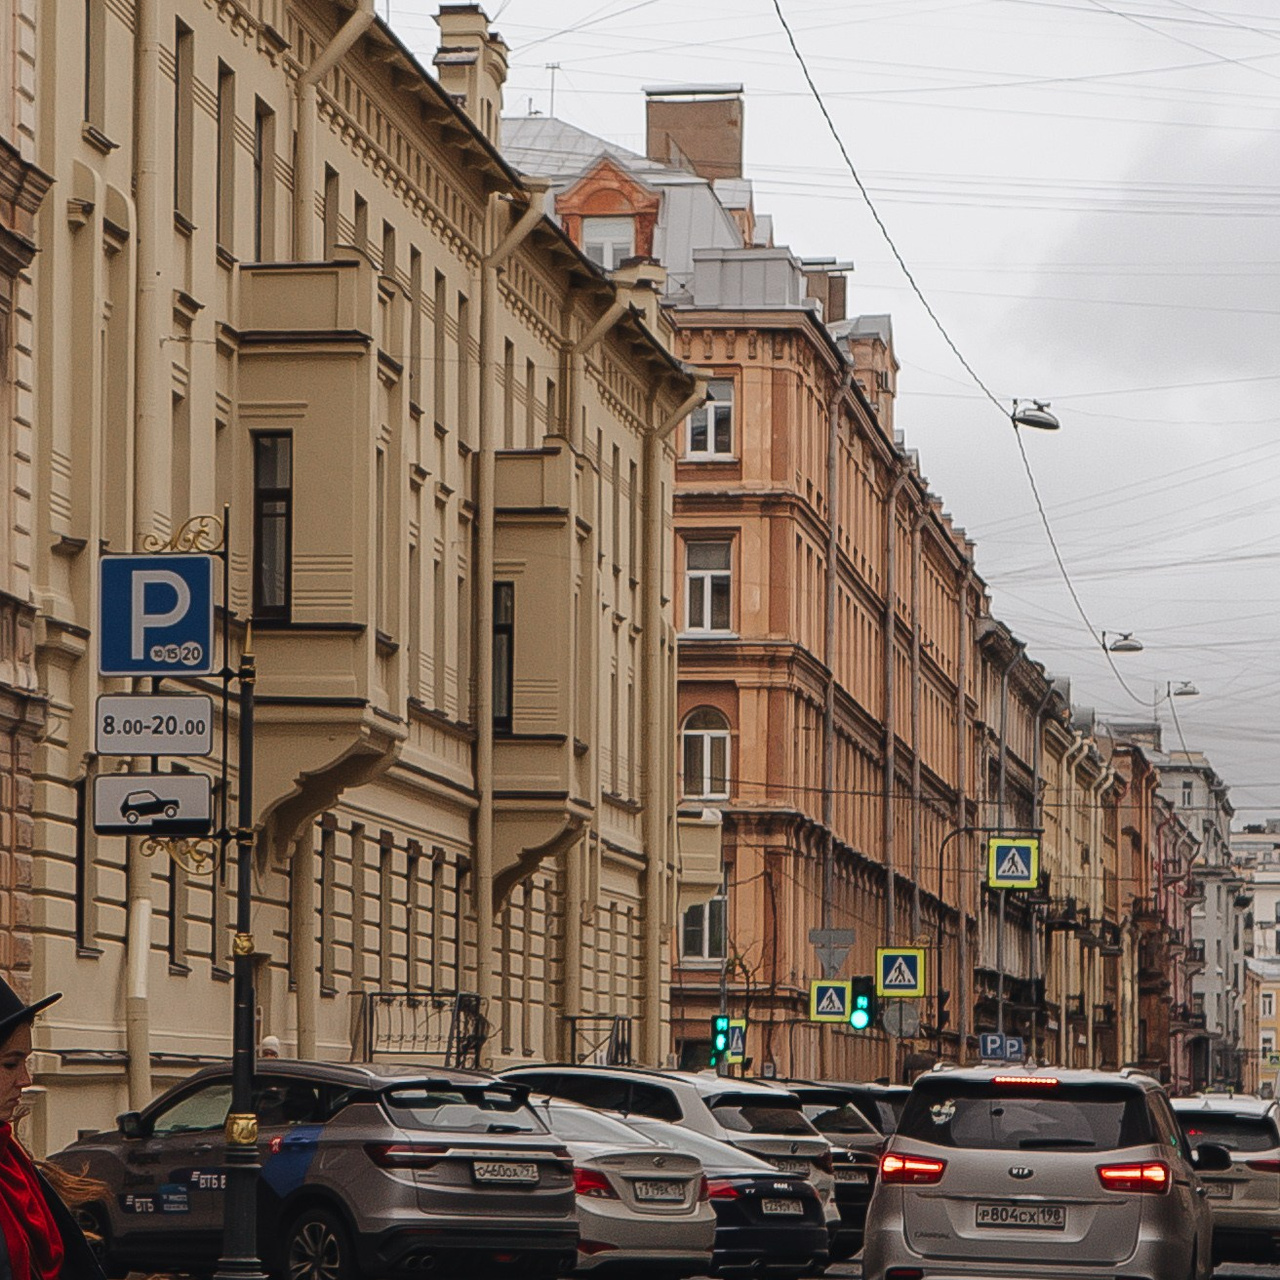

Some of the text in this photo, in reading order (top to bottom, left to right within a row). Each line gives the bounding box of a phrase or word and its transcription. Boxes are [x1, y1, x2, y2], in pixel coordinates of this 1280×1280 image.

[131, 569, 191, 660] P
[153, 646, 201, 661] 10 15 20
[103, 715, 206, 735] 8.00-20.00
[987, 1035, 1001, 1055] P
[1006, 1039, 1019, 1058] P
[200, 1175, 218, 1188] ВТБ
[135, 1198, 154, 1212] ВТБ
[1040, 1208, 1061, 1221] 198
